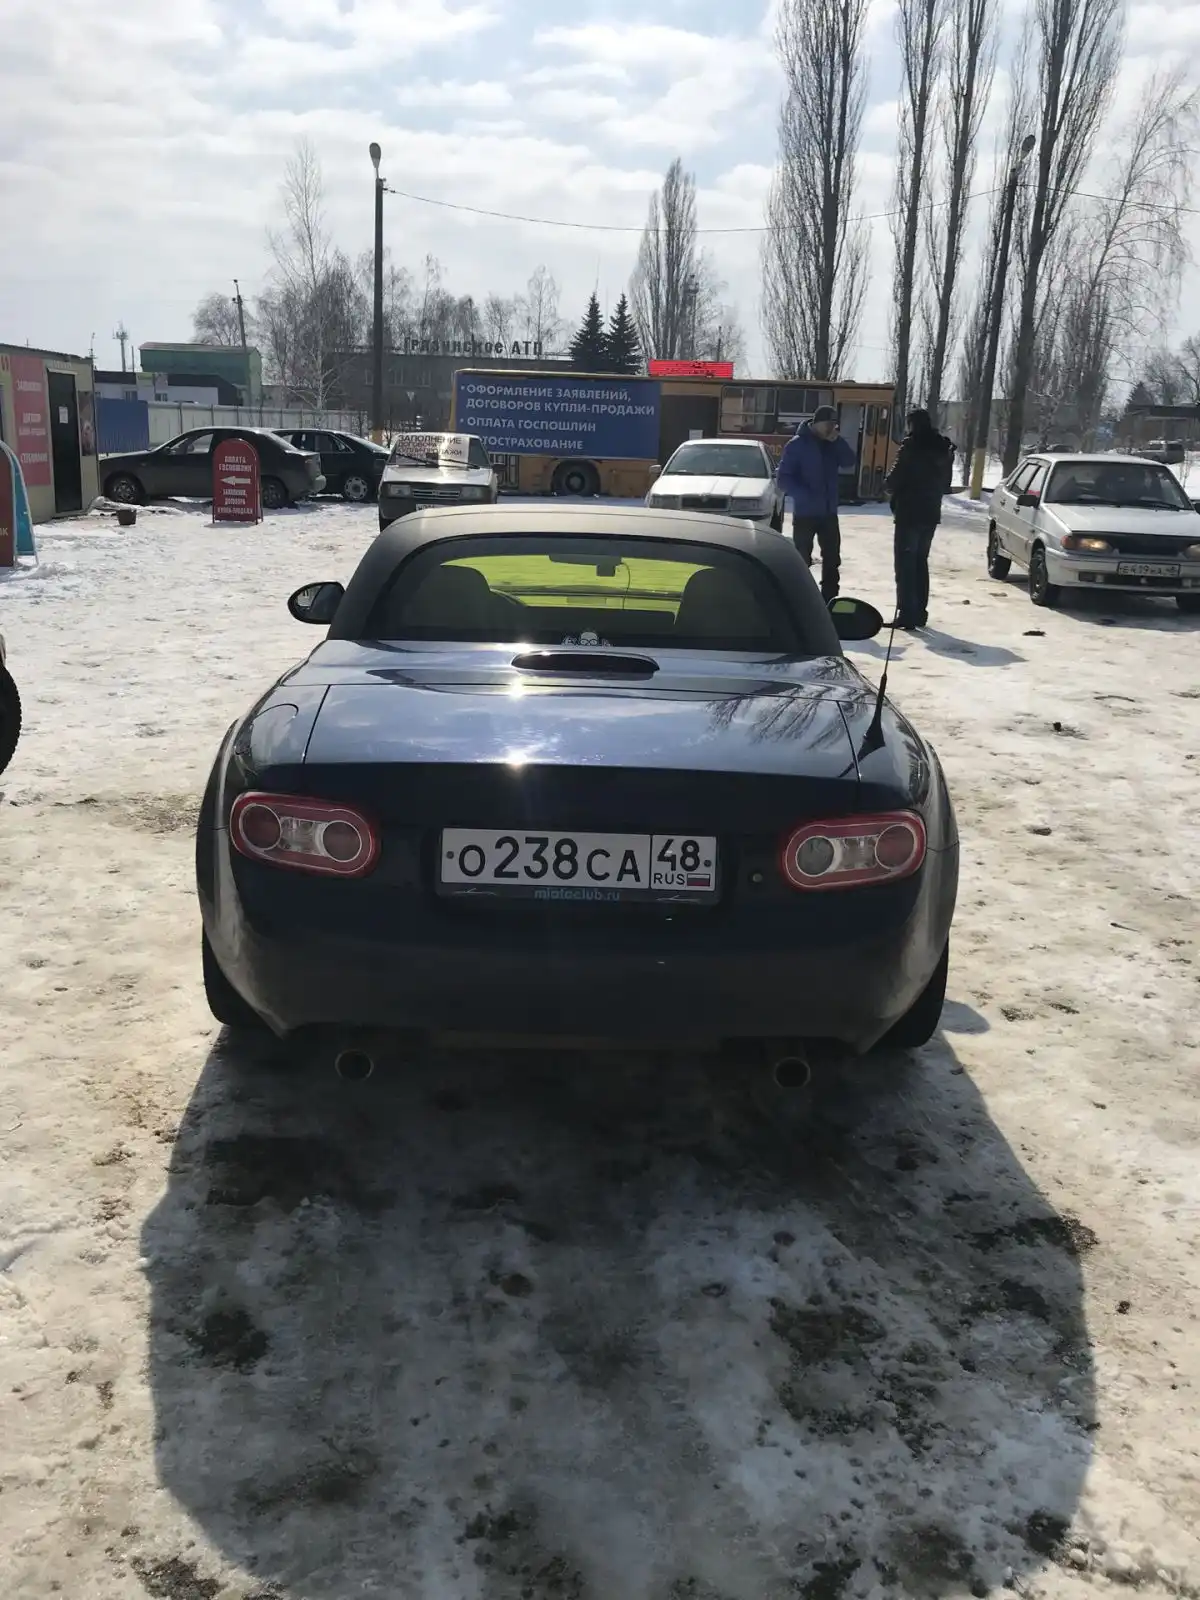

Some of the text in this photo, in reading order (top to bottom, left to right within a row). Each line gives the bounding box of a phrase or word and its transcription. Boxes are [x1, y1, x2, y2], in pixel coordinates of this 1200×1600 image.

[467, 384, 632, 402] ОФОРМЛЕНИЕ ЗАЯВЛЕНИЙ,
[466, 398, 655, 416] ДОГОВОРОВ КУПЛИ-ПРОДАЖИ
[467, 416, 596, 433] ОПЛАТА ГОСПОШЛИН
[481, 435, 584, 450] ТОСТРАХОВАНИЕ
[656, 838, 700, 872] 48
[652, 872, 686, 886] RUS
